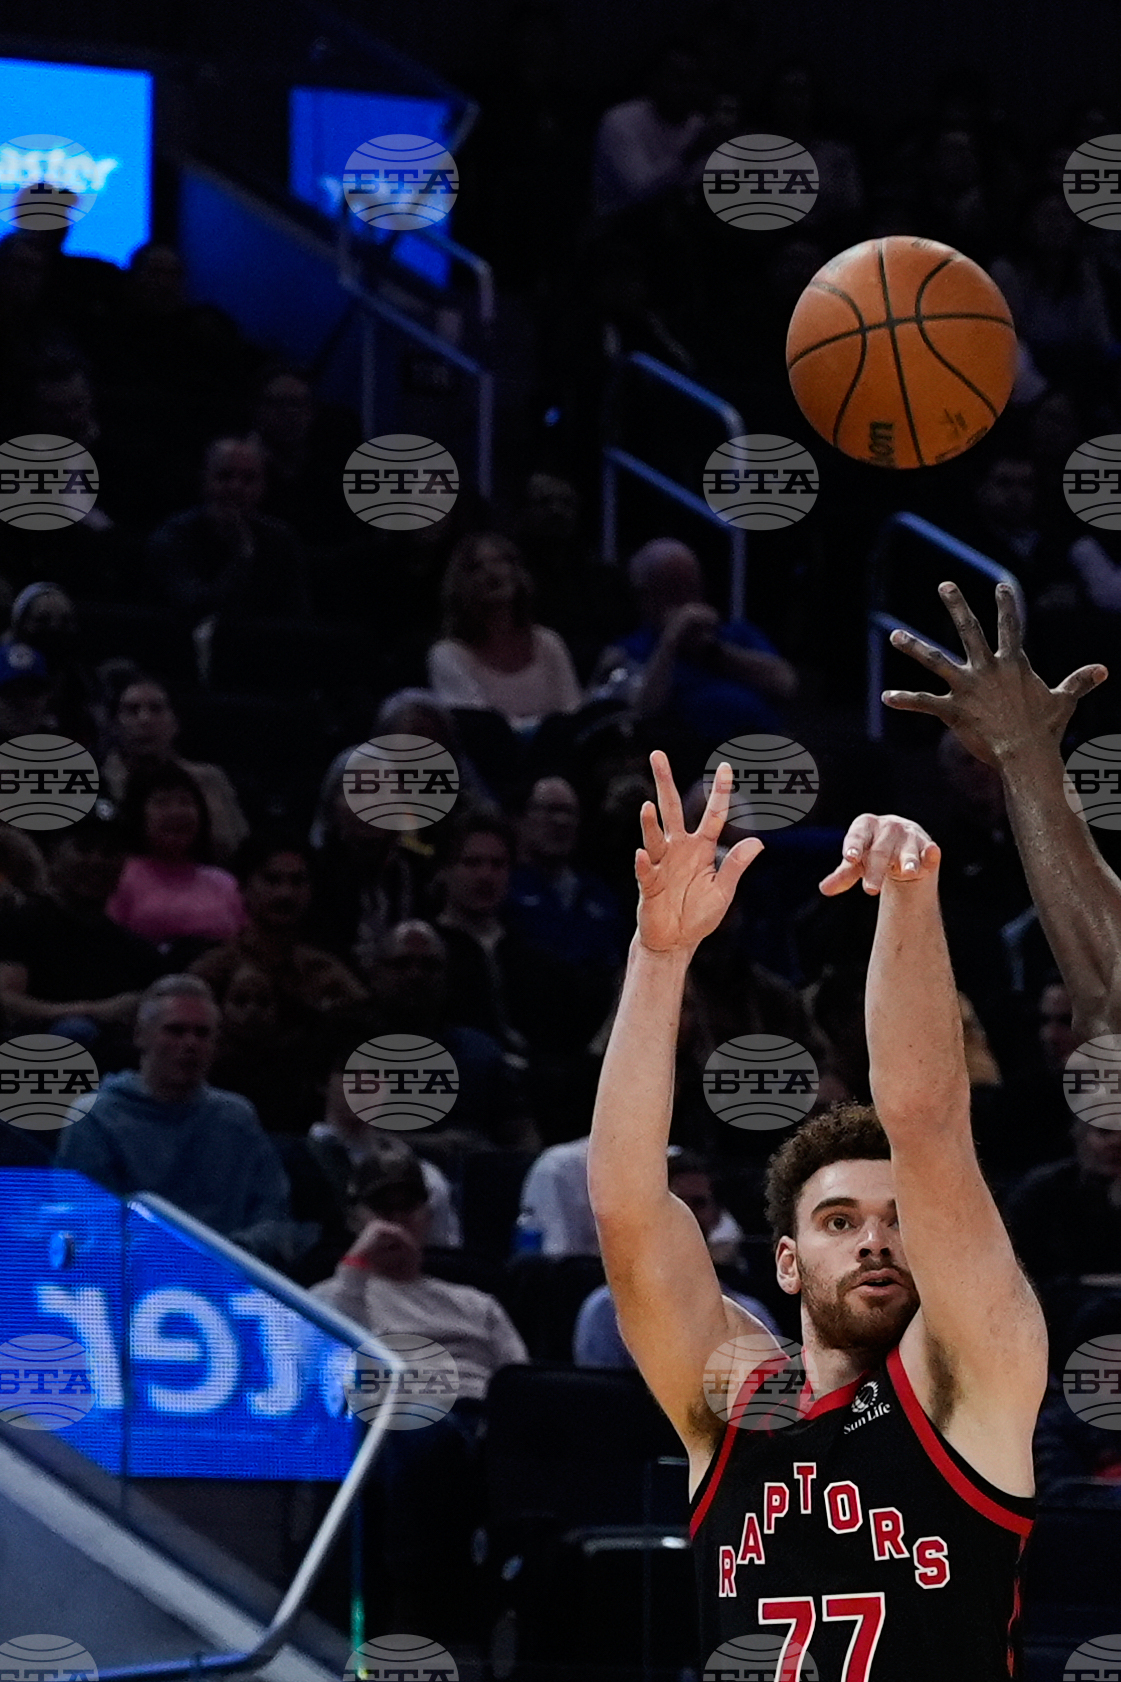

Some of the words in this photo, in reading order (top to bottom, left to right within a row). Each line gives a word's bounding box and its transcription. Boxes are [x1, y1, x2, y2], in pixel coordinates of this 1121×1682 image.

[843, 1416, 866, 1435] Sun
[867, 1402, 891, 1421] Life
[718, 1462, 951, 1598] RAPTORS
